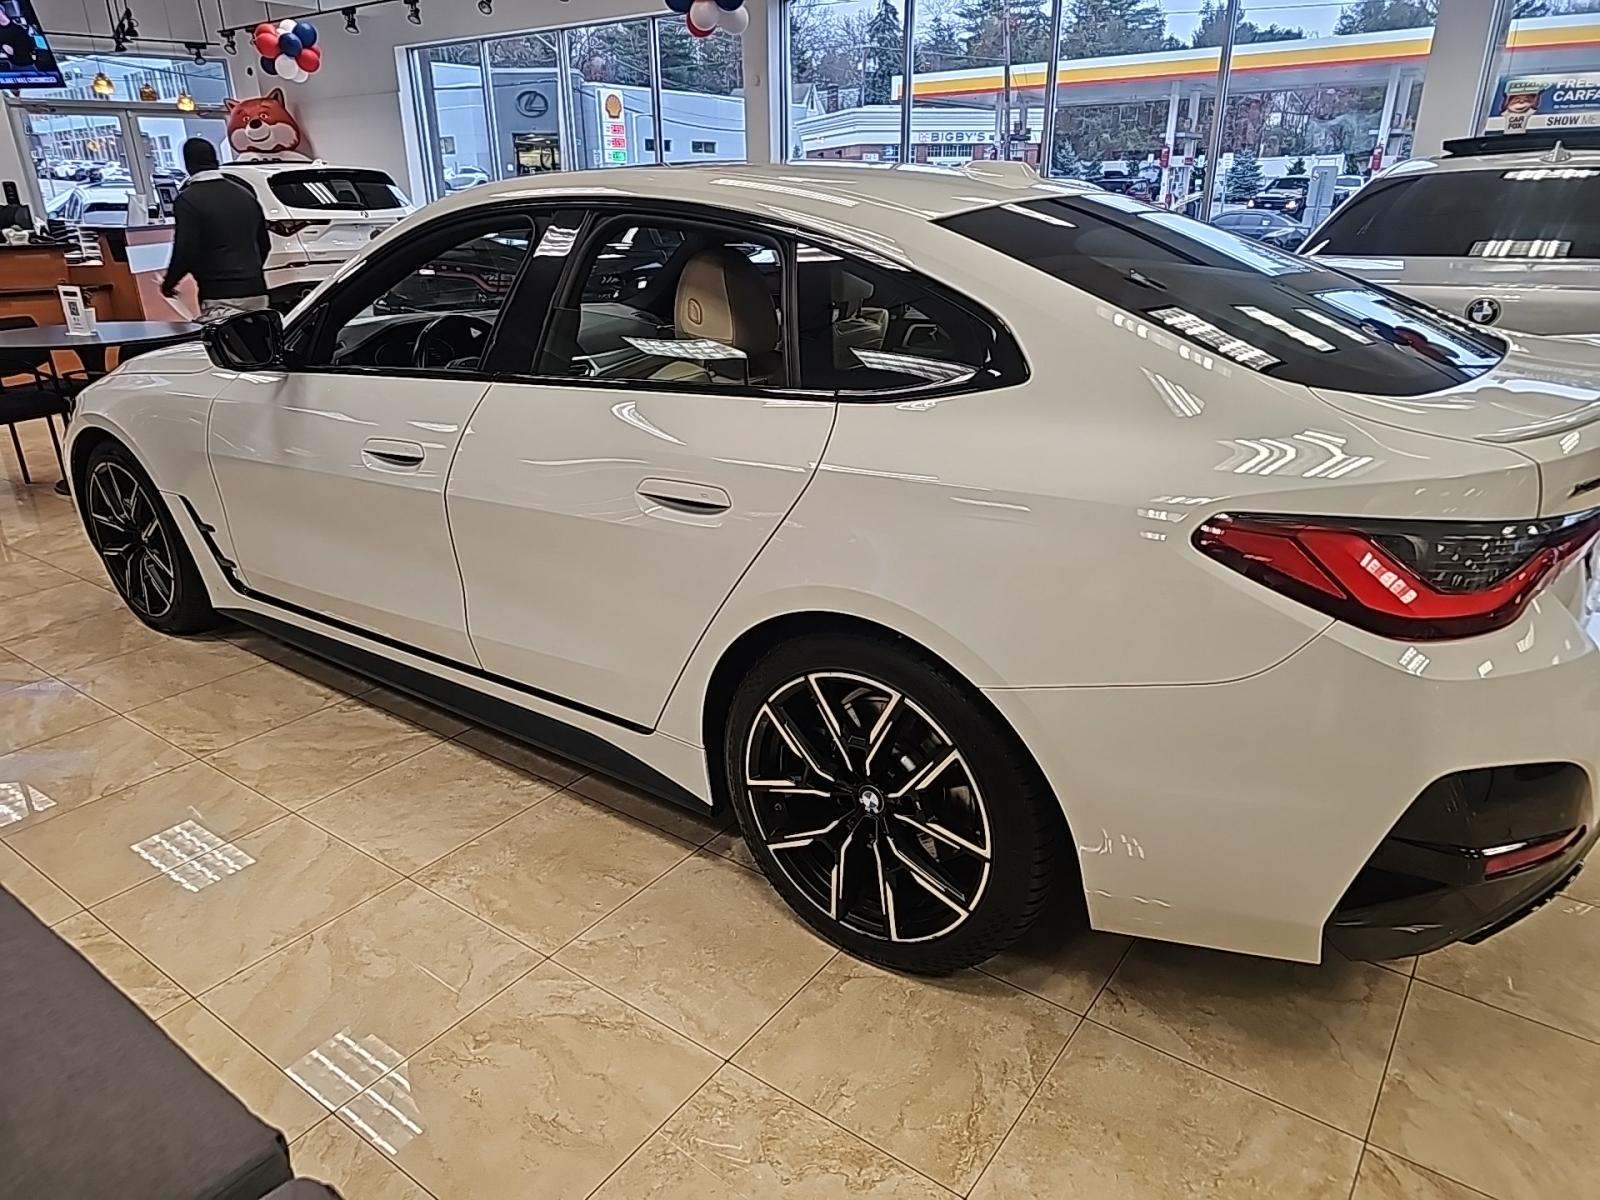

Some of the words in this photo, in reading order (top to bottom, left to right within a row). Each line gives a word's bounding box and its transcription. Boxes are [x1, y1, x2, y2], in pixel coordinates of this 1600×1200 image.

[1556, 78, 1594, 89] FREE
[1508, 115, 1525, 123] CAR
[1546, 115, 1580, 126] SHOW
[1507, 122, 1523, 130] FOX
[930, 132, 986, 142] BIGBY'S
